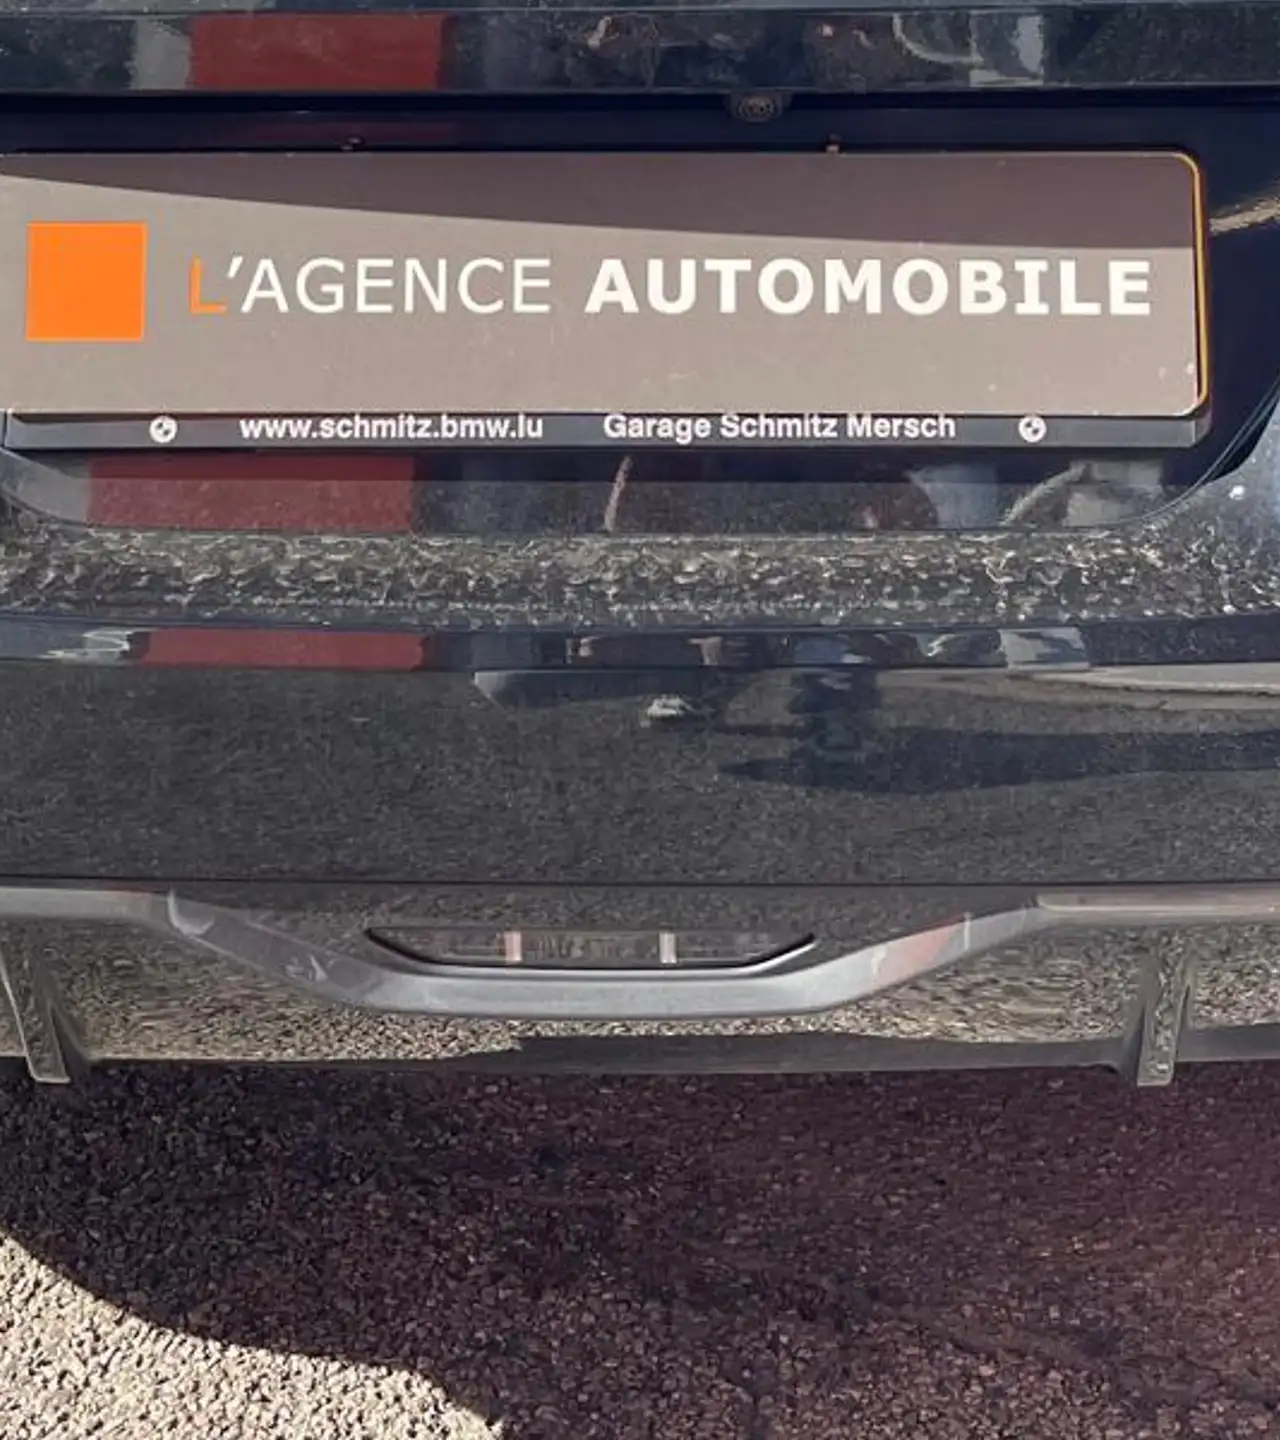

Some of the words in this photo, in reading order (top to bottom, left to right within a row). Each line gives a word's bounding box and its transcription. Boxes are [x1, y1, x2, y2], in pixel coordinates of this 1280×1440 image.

[188, 256, 551, 314] L'AGENCE
[584, 259, 1151, 316] AUTOMOBILE
[239, 413, 544, 440] www.schmitz.bmw.lu
[603, 414, 712, 445] Garage
[719, 413, 839, 439] Schmitz
[846, 413, 956, 439] Mersch
